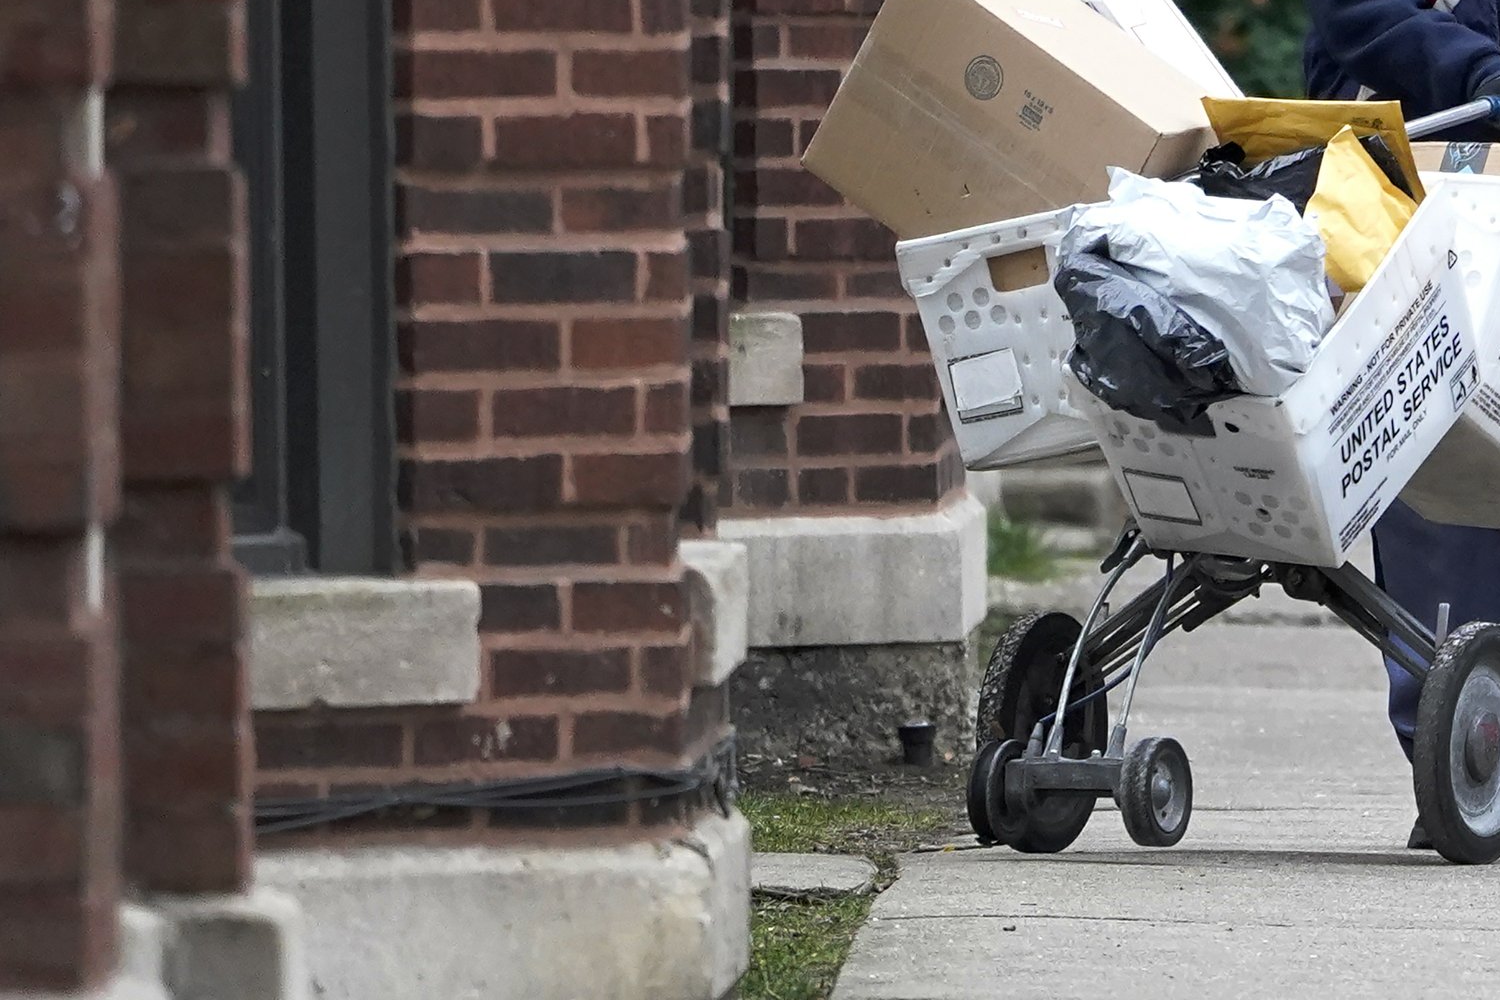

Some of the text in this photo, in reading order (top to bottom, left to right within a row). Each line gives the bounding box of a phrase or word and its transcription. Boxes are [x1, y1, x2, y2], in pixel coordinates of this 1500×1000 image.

[1330, 374, 1363, 416] WARNING
[1367, 352, 1380, 371] NOT
[1381, 333, 1396, 354] FOR
[1395, 298, 1420, 335] PRIVATE
[1420, 280, 1434, 301] USE
[1340, 389, 1393, 463] UNITED
[1397, 315, 1450, 395] STATES
[1341, 418, 1400, 498] POSTAL
[1402, 332, 1463, 422] SERVICE
[1386, 446, 1400, 463] FOR
[1412, 409, 1428, 430] ONLY
